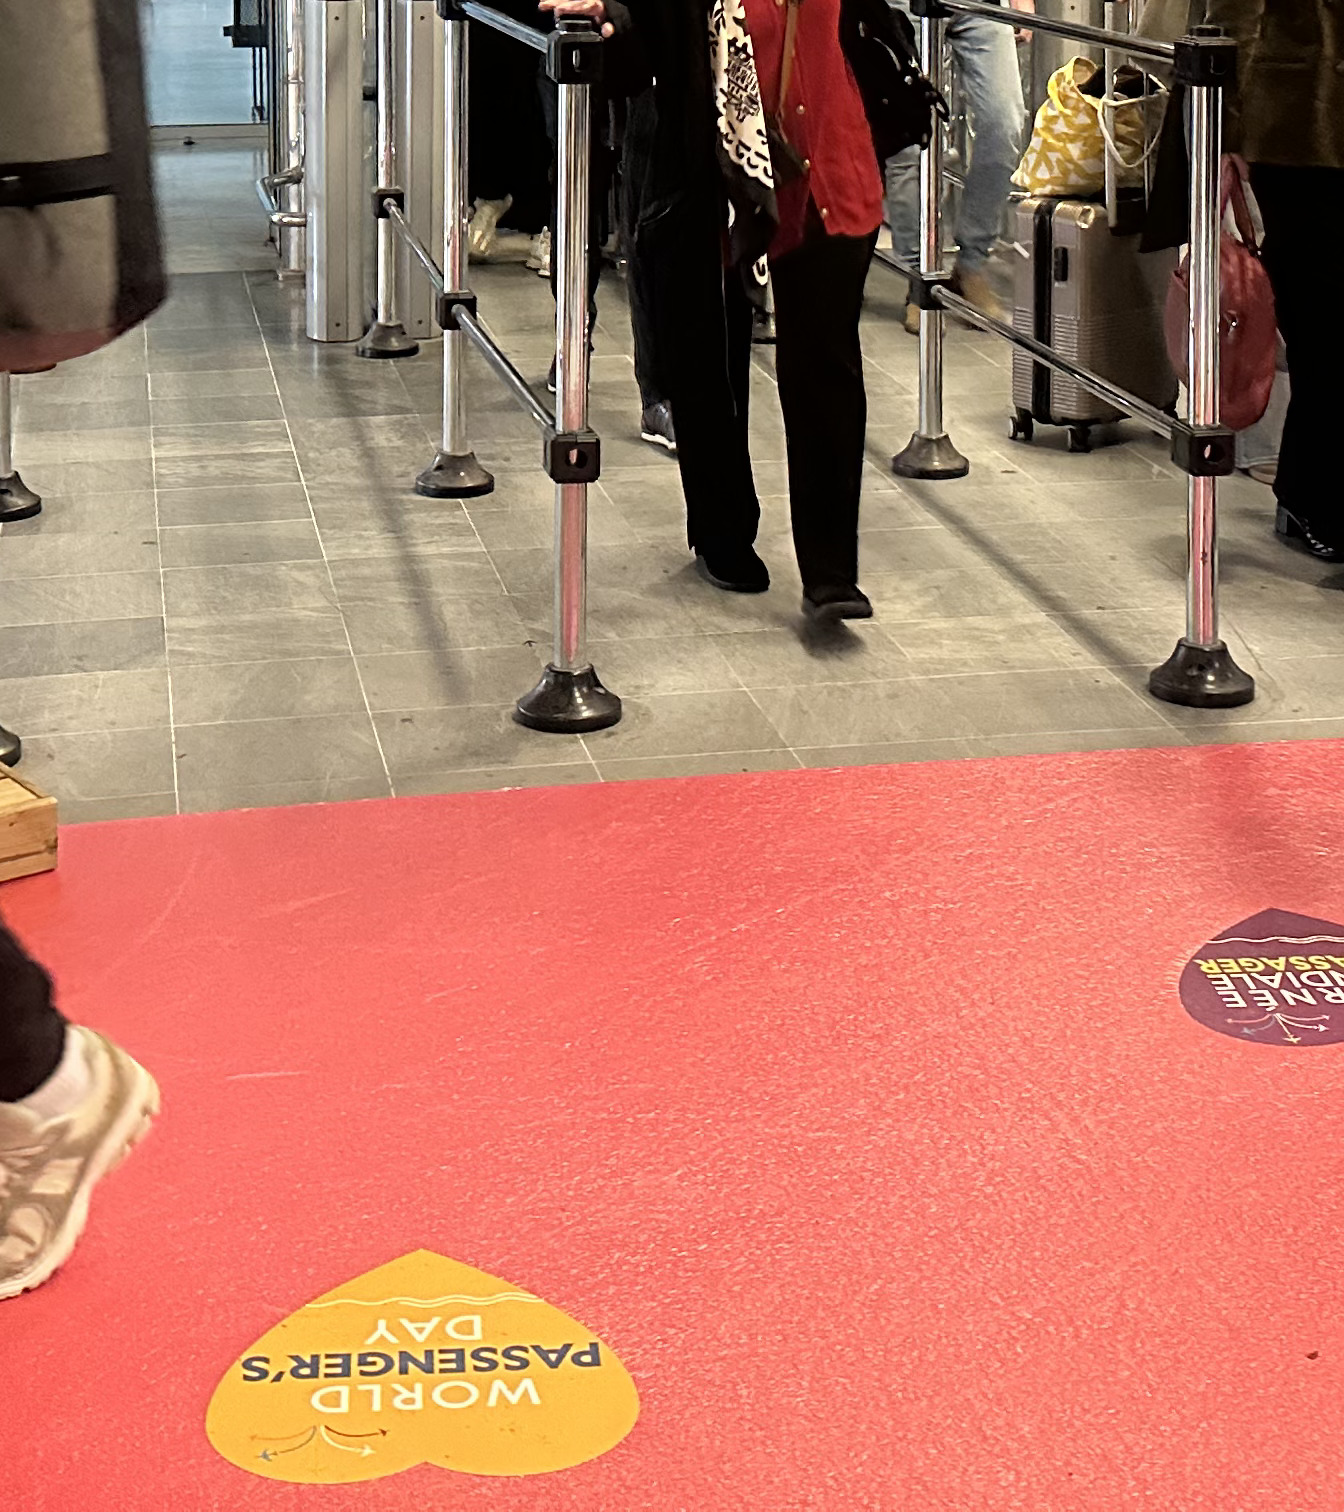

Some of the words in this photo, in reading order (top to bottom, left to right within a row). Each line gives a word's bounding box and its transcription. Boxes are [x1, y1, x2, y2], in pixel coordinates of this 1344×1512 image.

[363, 1314, 483, 1345] DAY
[241, 1341, 602, 1383] PASSENGER'S
[310, 1377, 542, 1413] WORLD
